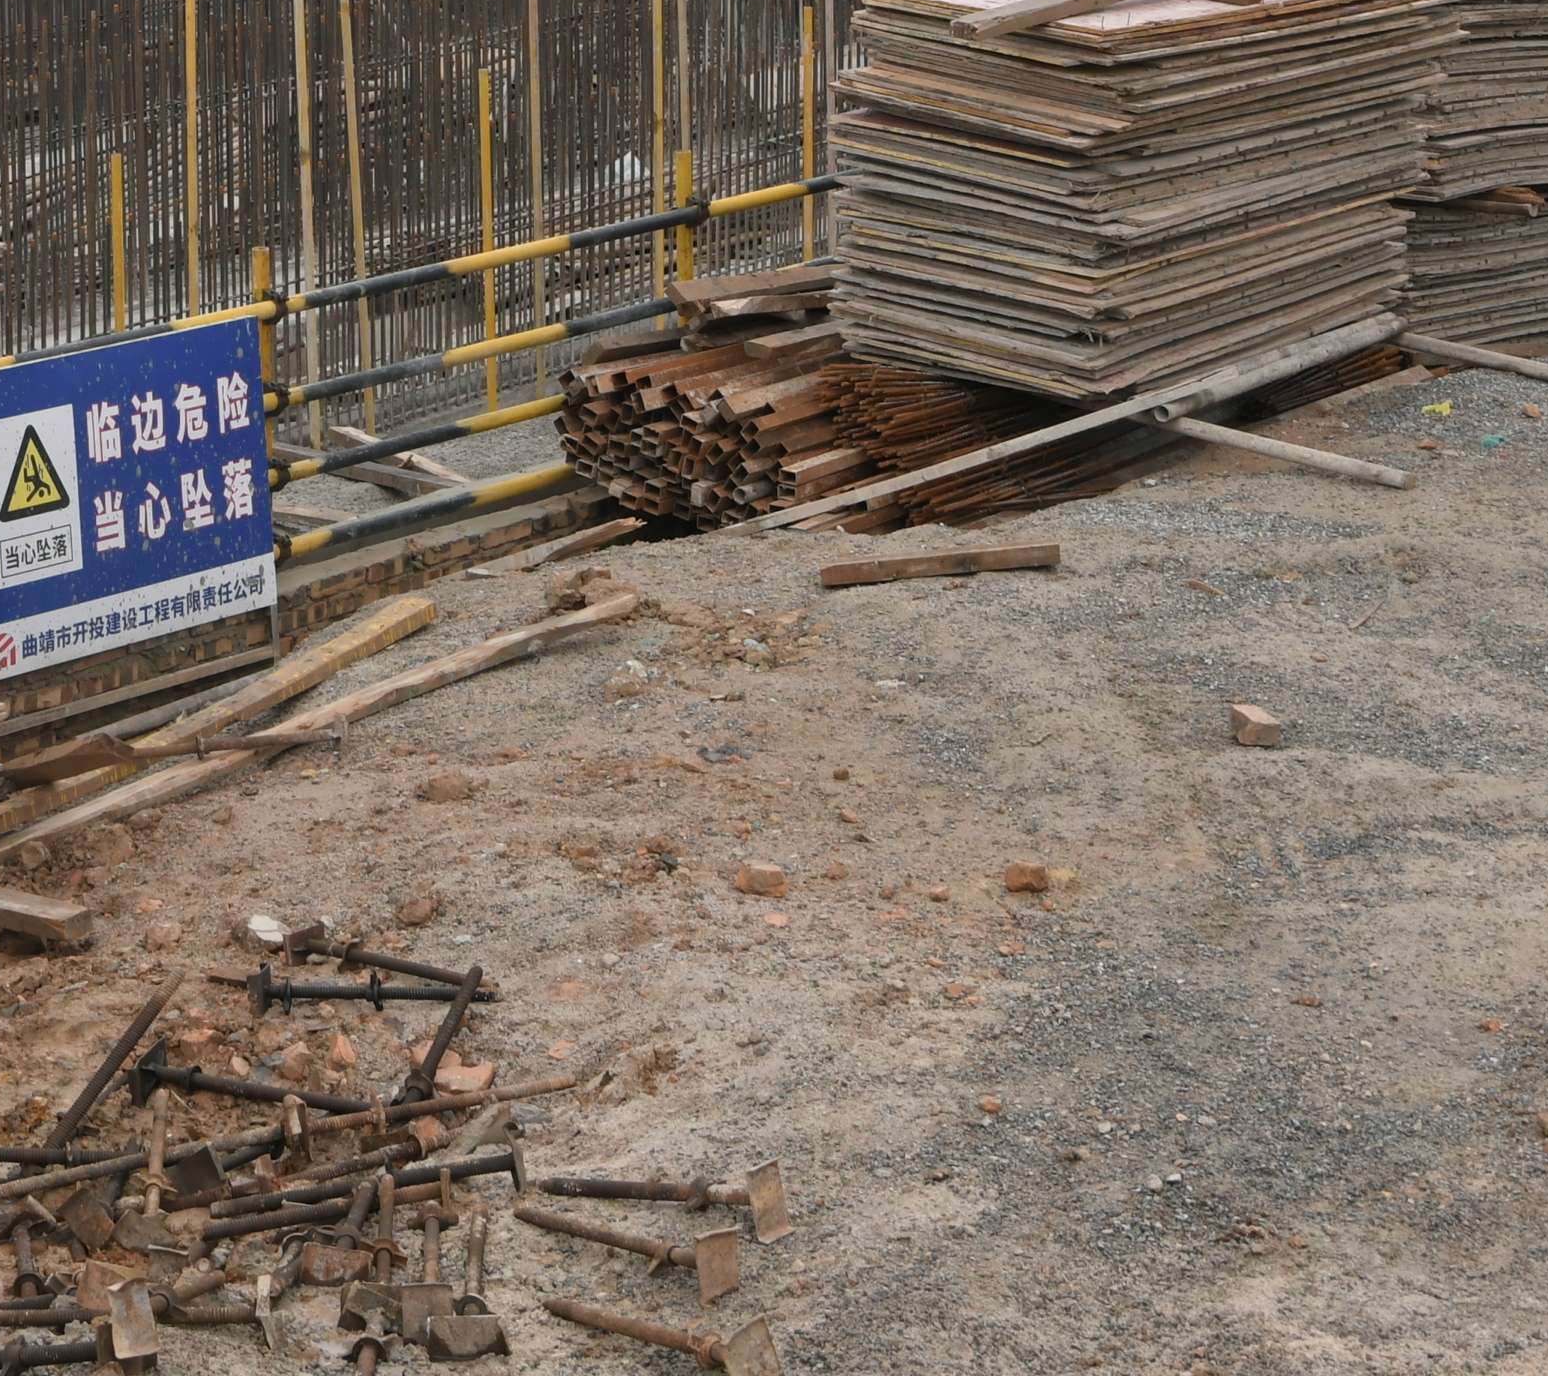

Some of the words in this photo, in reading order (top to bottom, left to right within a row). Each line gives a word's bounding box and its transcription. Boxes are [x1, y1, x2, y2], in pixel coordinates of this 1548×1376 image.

[86, 371, 251, 463] 临边危险
[93, 458, 255, 553] 当心坠落
[4, 533, 69, 570] 当心坠落
[21, 573, 265, 659] 曲靖市开投建设工程有限责任公司
